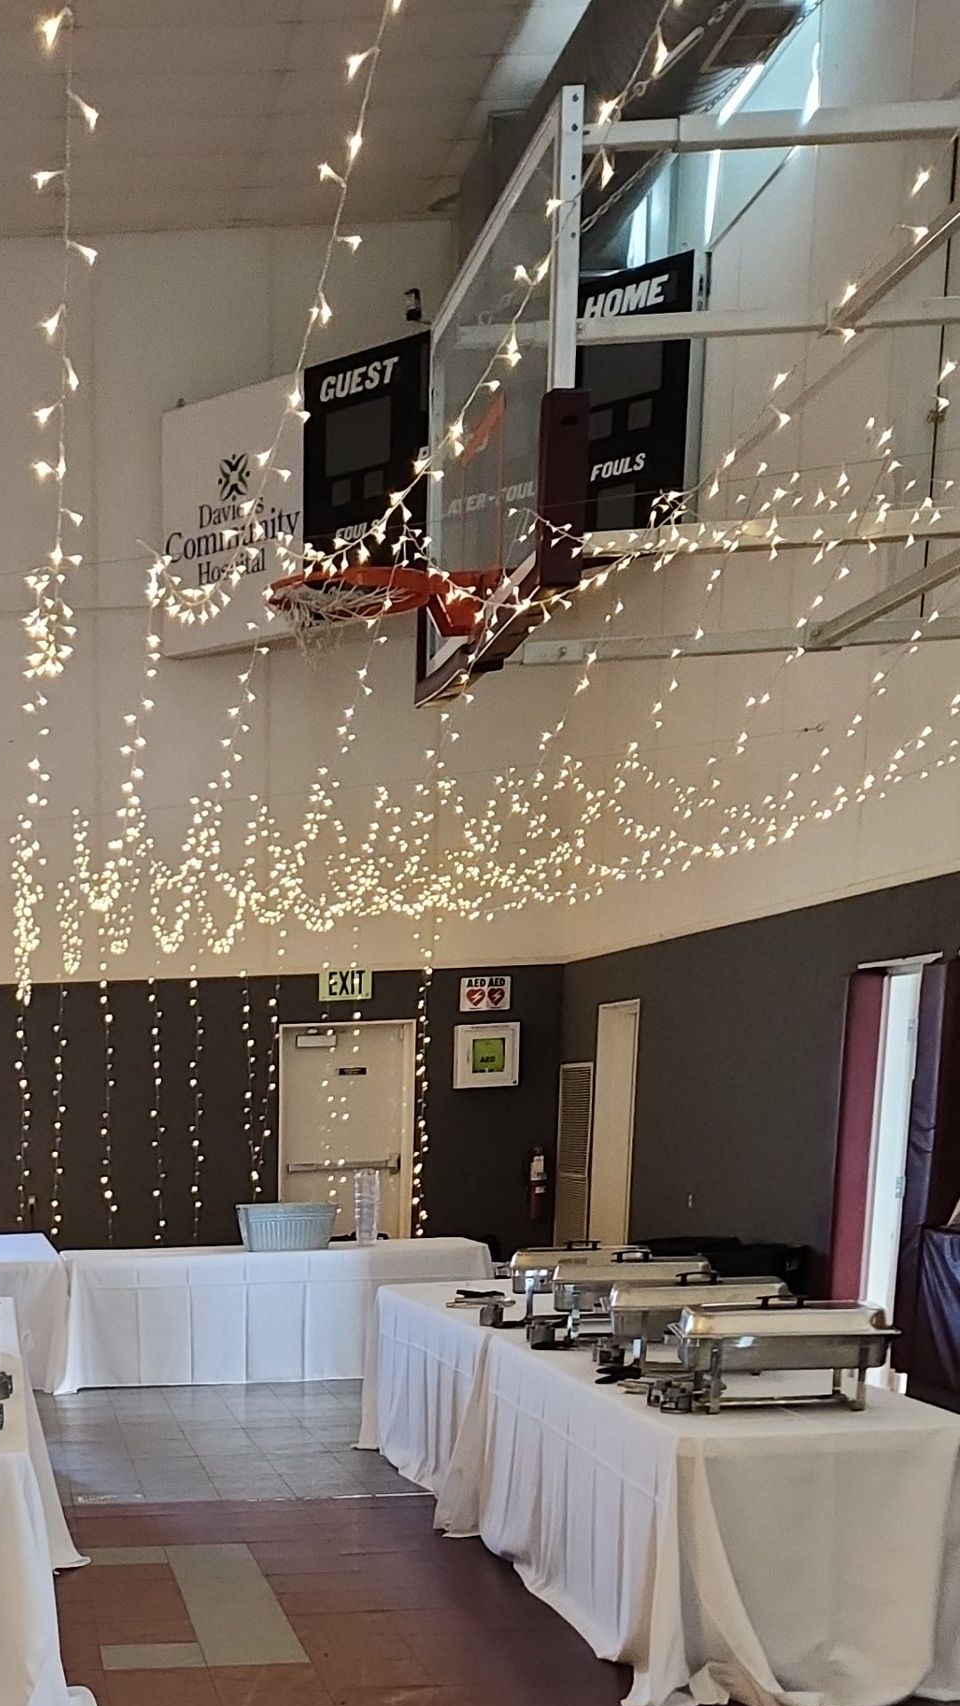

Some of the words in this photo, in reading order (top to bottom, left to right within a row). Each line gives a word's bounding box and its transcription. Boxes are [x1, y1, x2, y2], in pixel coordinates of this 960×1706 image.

[583, 273, 670, 319] HOME
[319, 356, 401, 403] GUEST
[590, 452, 647, 482] FOULS
[197, 547, 266, 586] Hosital
[328, 969, 366, 996] EXIT
[466, 978, 487, 988] AED
[487, 977, 506, 988] AED
